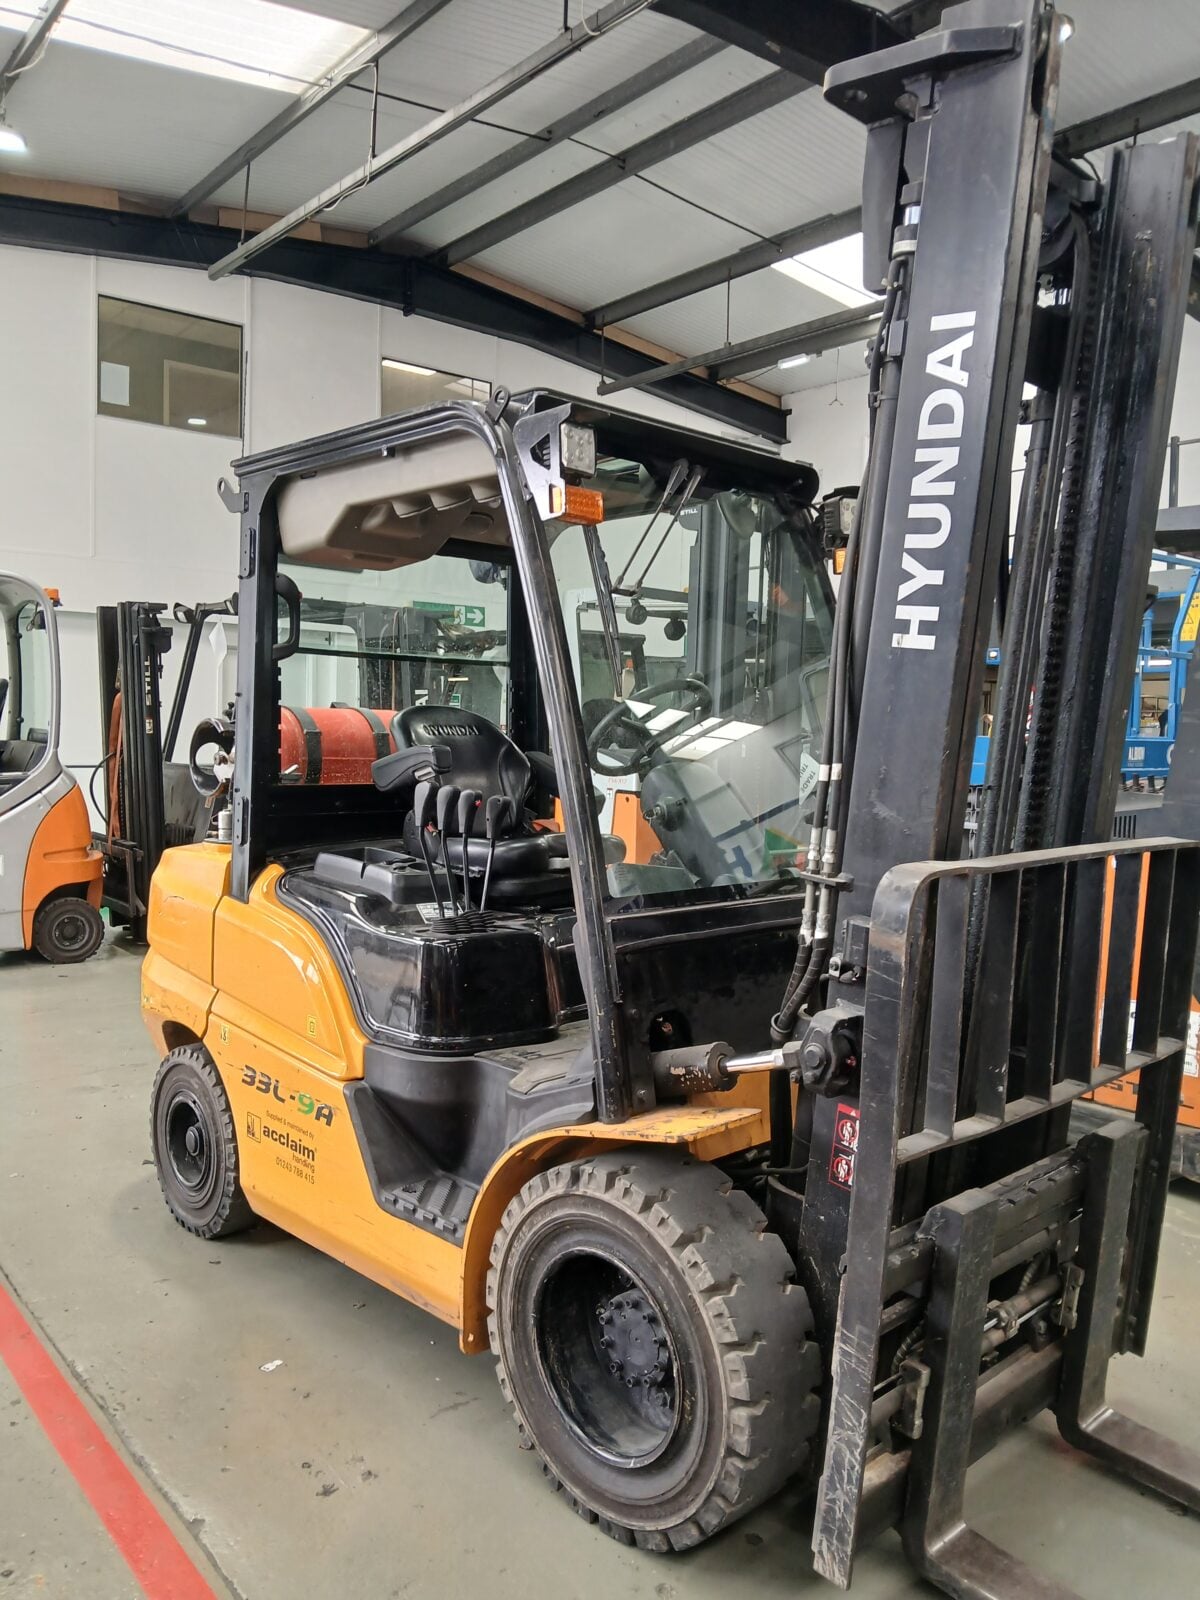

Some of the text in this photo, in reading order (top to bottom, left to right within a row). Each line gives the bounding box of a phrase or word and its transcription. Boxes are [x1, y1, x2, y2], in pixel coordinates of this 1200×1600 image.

[892, 310, 976, 650] HYUNDAI
[144, 656, 152, 706] STILL
[422, 724, 480, 737] HYUNDAI
[242, 1064, 334, 1127] 33L-9A
[263, 1125, 315, 1161] acclaim
[293, 1152, 315, 1174] handling
[305, 1174, 315, 1185] 415
